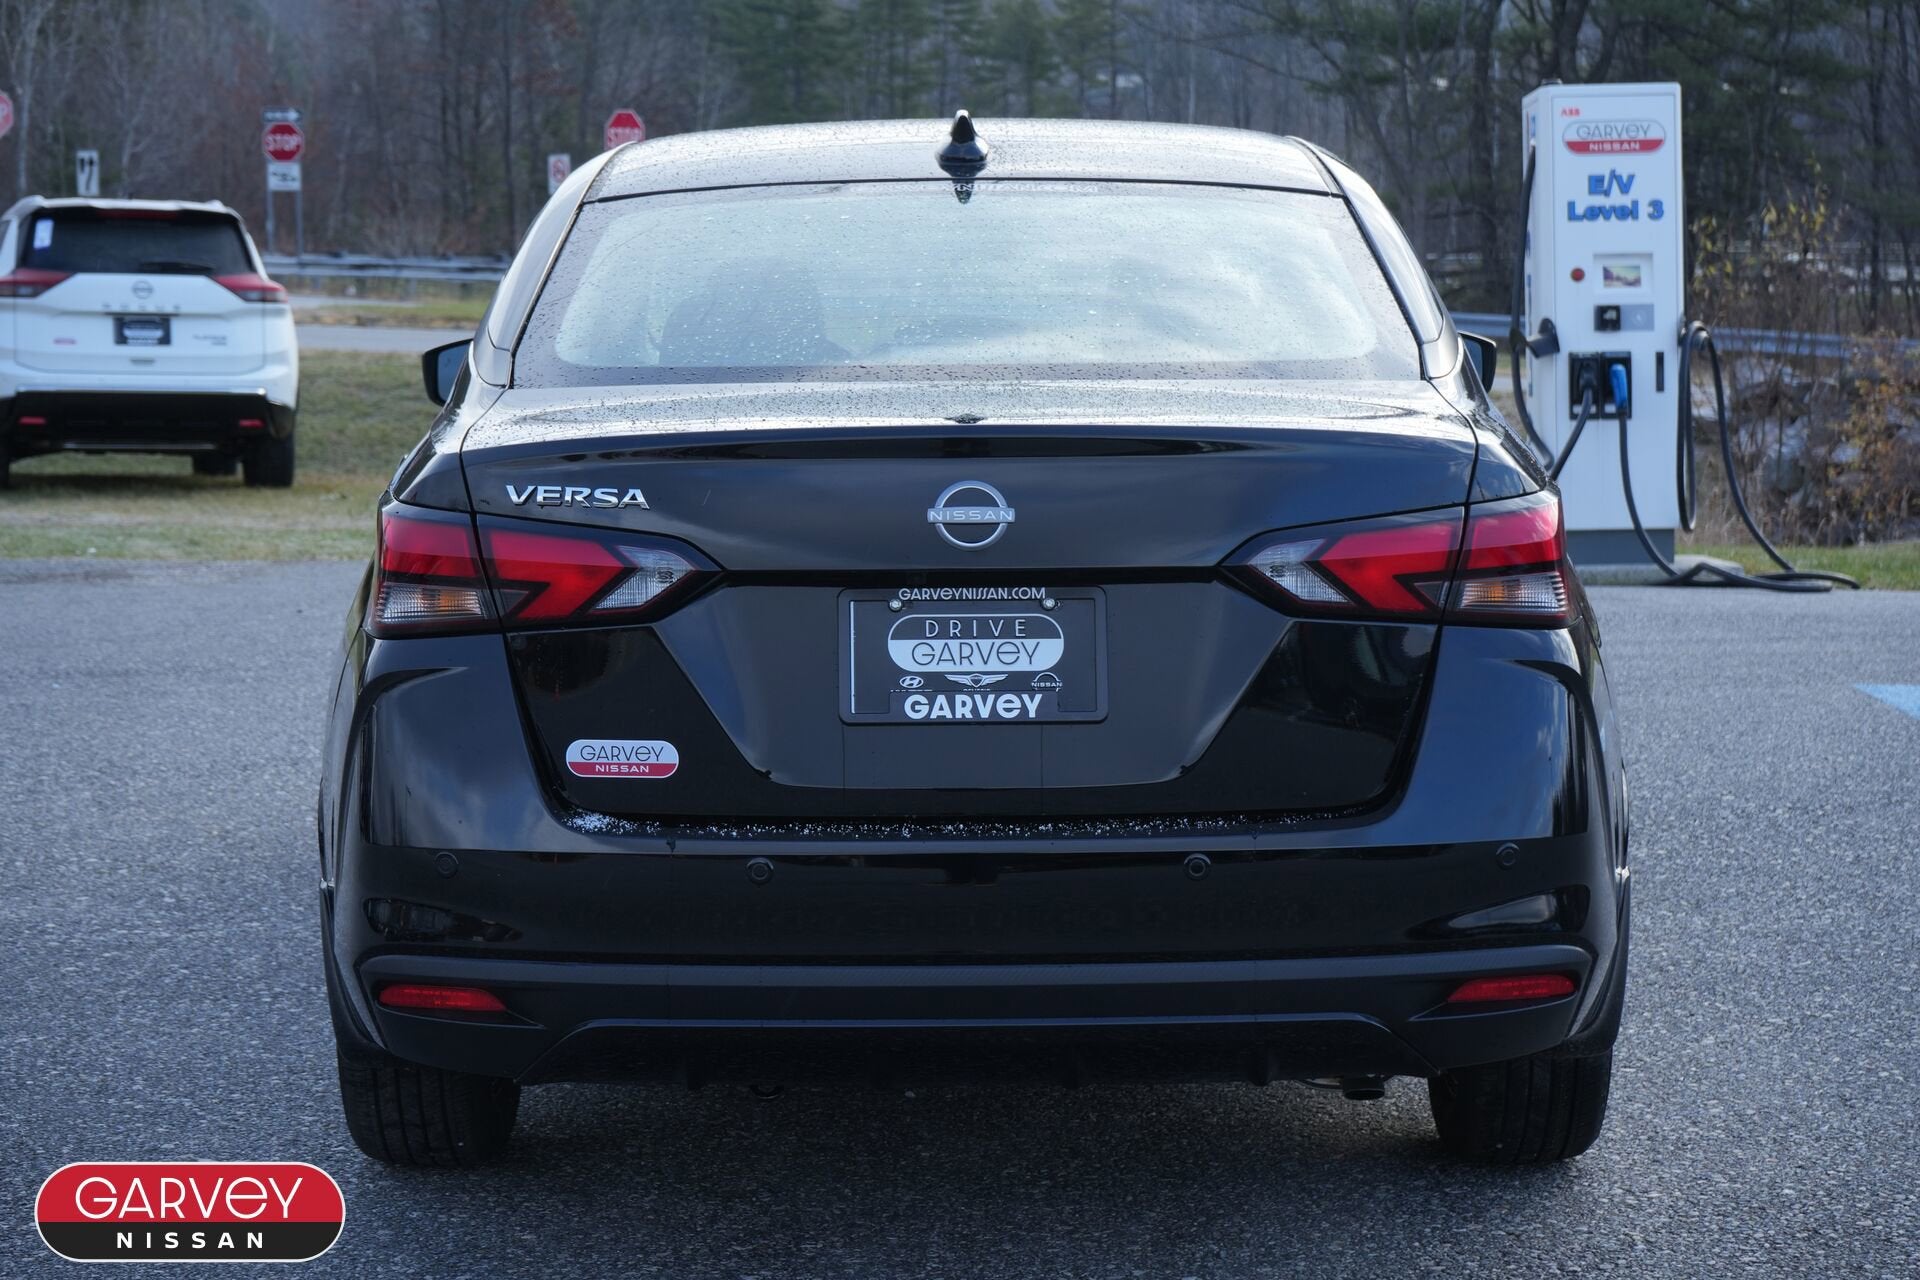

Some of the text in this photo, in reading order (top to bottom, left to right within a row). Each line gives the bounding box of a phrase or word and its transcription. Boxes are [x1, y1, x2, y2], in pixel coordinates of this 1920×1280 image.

[264, 134, 302, 151] STOP
[1589, 142, 1640, 151] NISSAN
[1588, 169, 1635, 197] E/V
[1567, 200, 1664, 221] Level 3
[506, 484, 650, 510] VERSA
[930, 510, 1012, 521] NISSAN
[925, 619, 1026, 638] DRIVE
[595, 764, 649, 773] NISSAN
